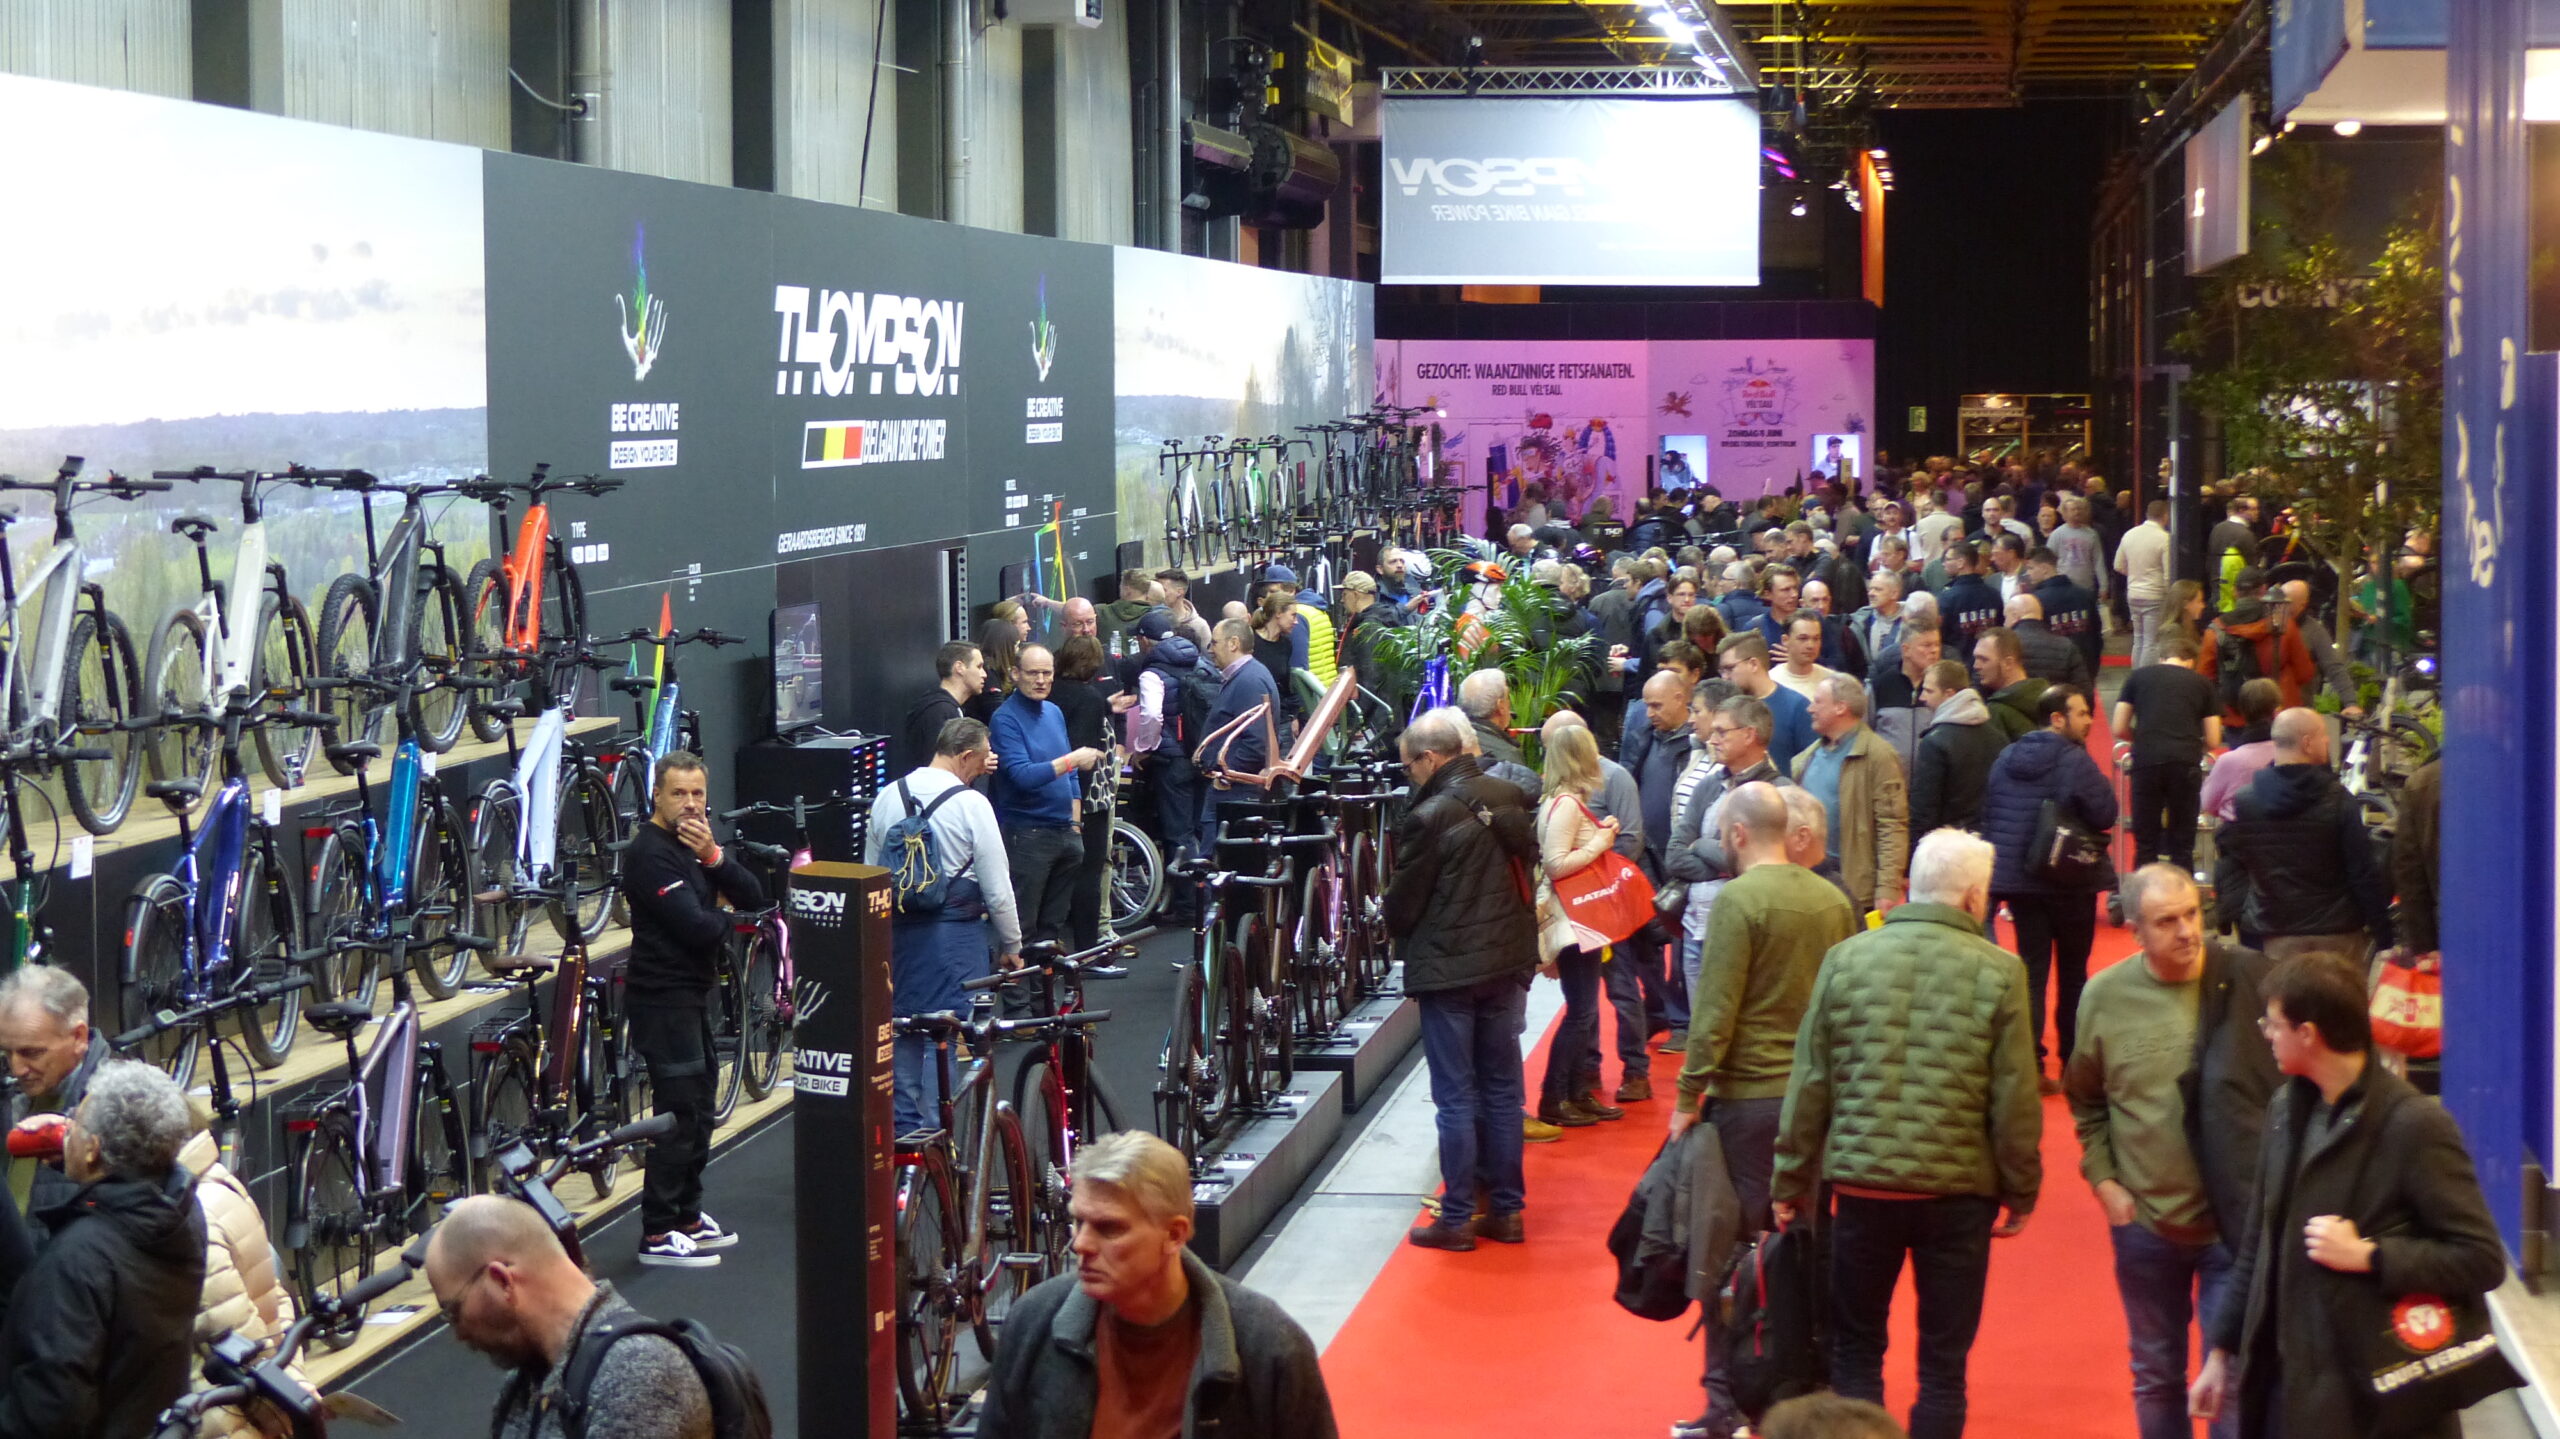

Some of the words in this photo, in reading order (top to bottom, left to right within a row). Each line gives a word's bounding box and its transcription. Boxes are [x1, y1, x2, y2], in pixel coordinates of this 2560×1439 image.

[775, 285, 964, 397] THOMPSON
[1416, 363, 1471, 380] GEZOCHT:
[1475, 363, 1556, 380] WAANZINNIGE
[1558, 363, 1635, 380] FIETSFANATEN.
[1491, 384, 1507, 396] RED
[1509, 384, 1528, 396] BULL
[611, 403, 628, 432] BE
[628, 403, 680, 432] CREATIVE
[1026, 398, 1036, 418] BE
[1036, 397, 1064, 418] CREATIVE
[863, 419, 900, 464] BELGIAN
[898, 419, 920, 461] BIKE
[918, 419, 947, 460] POWER
[614, 446, 640, 465] DESIGN
[640, 445, 658, 463] YOUR
[659, 444, 675, 462] BIKE
[571, 521, 587, 539] TYPE
[777, 526, 837, 554] GERAARDSBERGEN
[835, 524, 855, 545] SINCE
[811, 1078, 841, 1093] BIKE
[2372, 1359, 2427, 1393] LOUIS
